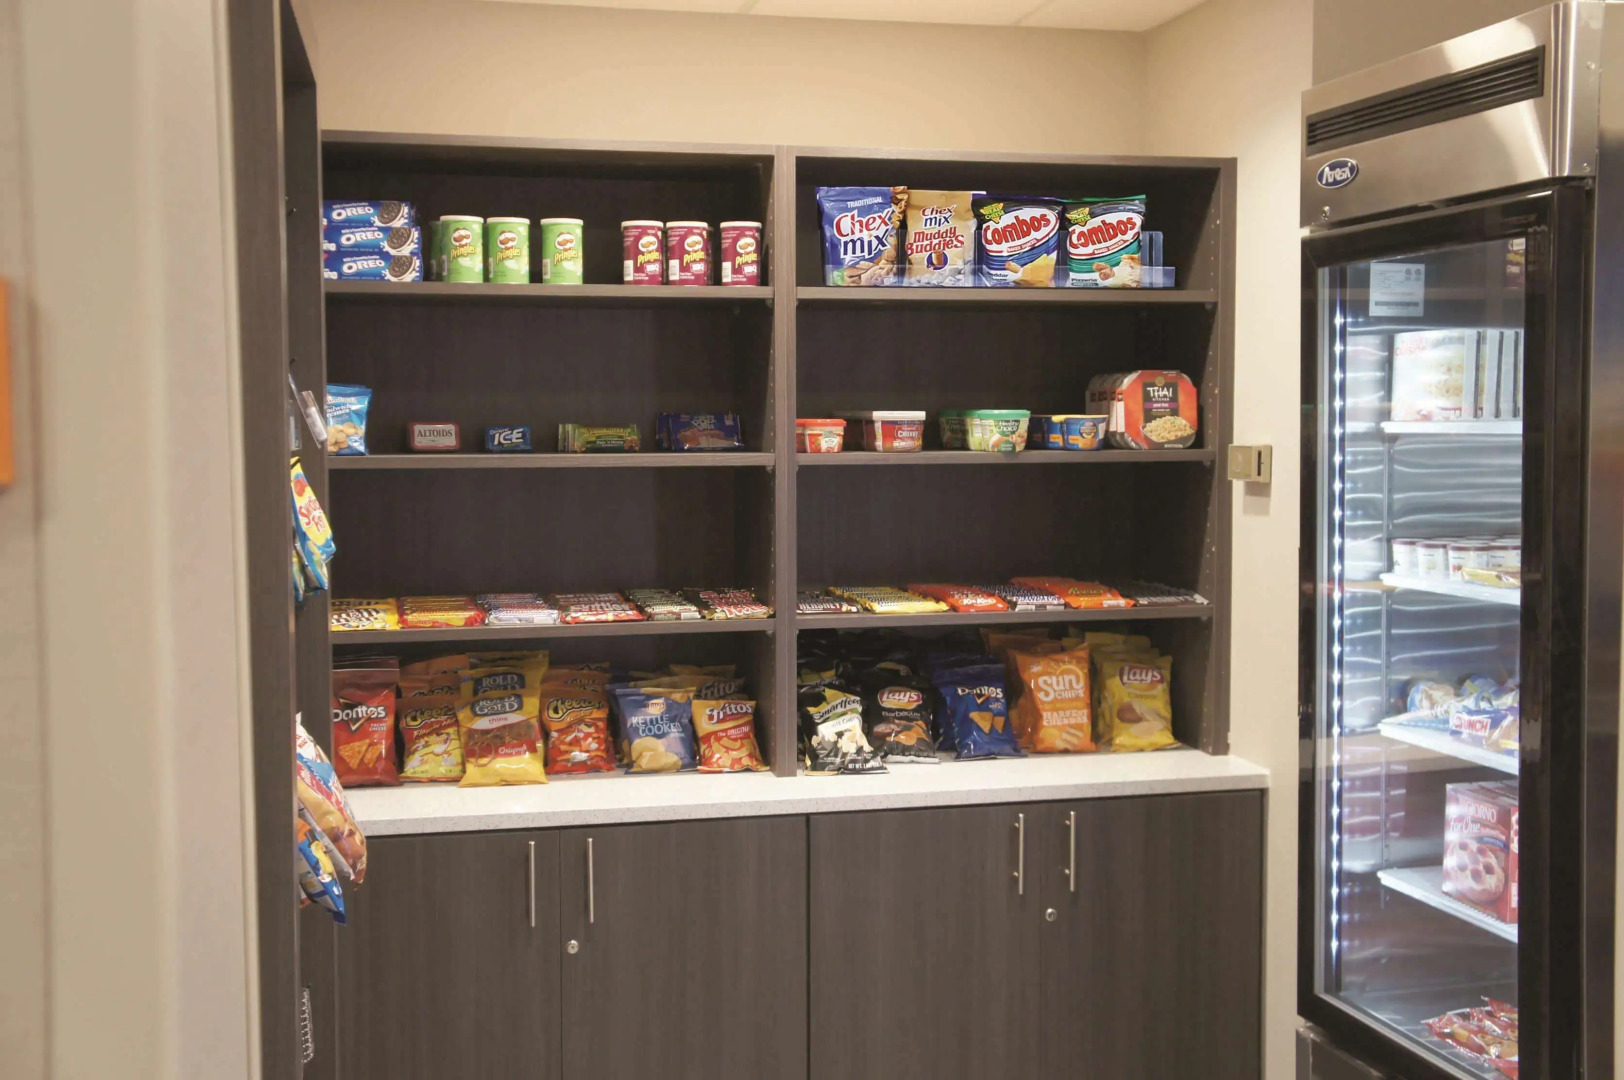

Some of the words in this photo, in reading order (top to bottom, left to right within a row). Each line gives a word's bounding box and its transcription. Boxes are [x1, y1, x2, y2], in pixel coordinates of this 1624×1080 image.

[846, 197, 883, 208] TRADITIONAL
[332, 206, 374, 220] OREO
[921, 205, 956, 217] Chex
[835, 208, 892, 238] Chex
[924, 215, 952, 227] mix
[913, 226, 957, 243] Muddy
[983, 214, 1051, 245] Combos
[1069, 217, 1137, 249] Combos
[340, 231, 383, 245] OREO
[842, 229, 890, 257] mix
[451, 244, 476, 260] Pringles
[907, 234, 964, 257] Buddies
[496, 247, 521, 263] Pringles
[342, 259, 385, 273] OREO
[1147, 387, 1172, 398] THAI
[416, 429, 452, 438] ALTOIDS
[494, 428, 523, 445] ICE
[482, 674, 518, 687] ROLD
[957, 686, 1003, 698] Doritos
[1038, 674, 1084, 702] Sun
[1054, 689, 1084, 699] CHIPS
[333, 705, 386, 722] Doritos
[475, 702, 518, 714] GOLD
[1043, 709, 1088, 719] HARVEST
[488, 716, 508, 725] thins
[632, 714, 670, 727] KETTLE
[639, 722, 682, 736] COOKED
[498, 744, 527, 755] Original
